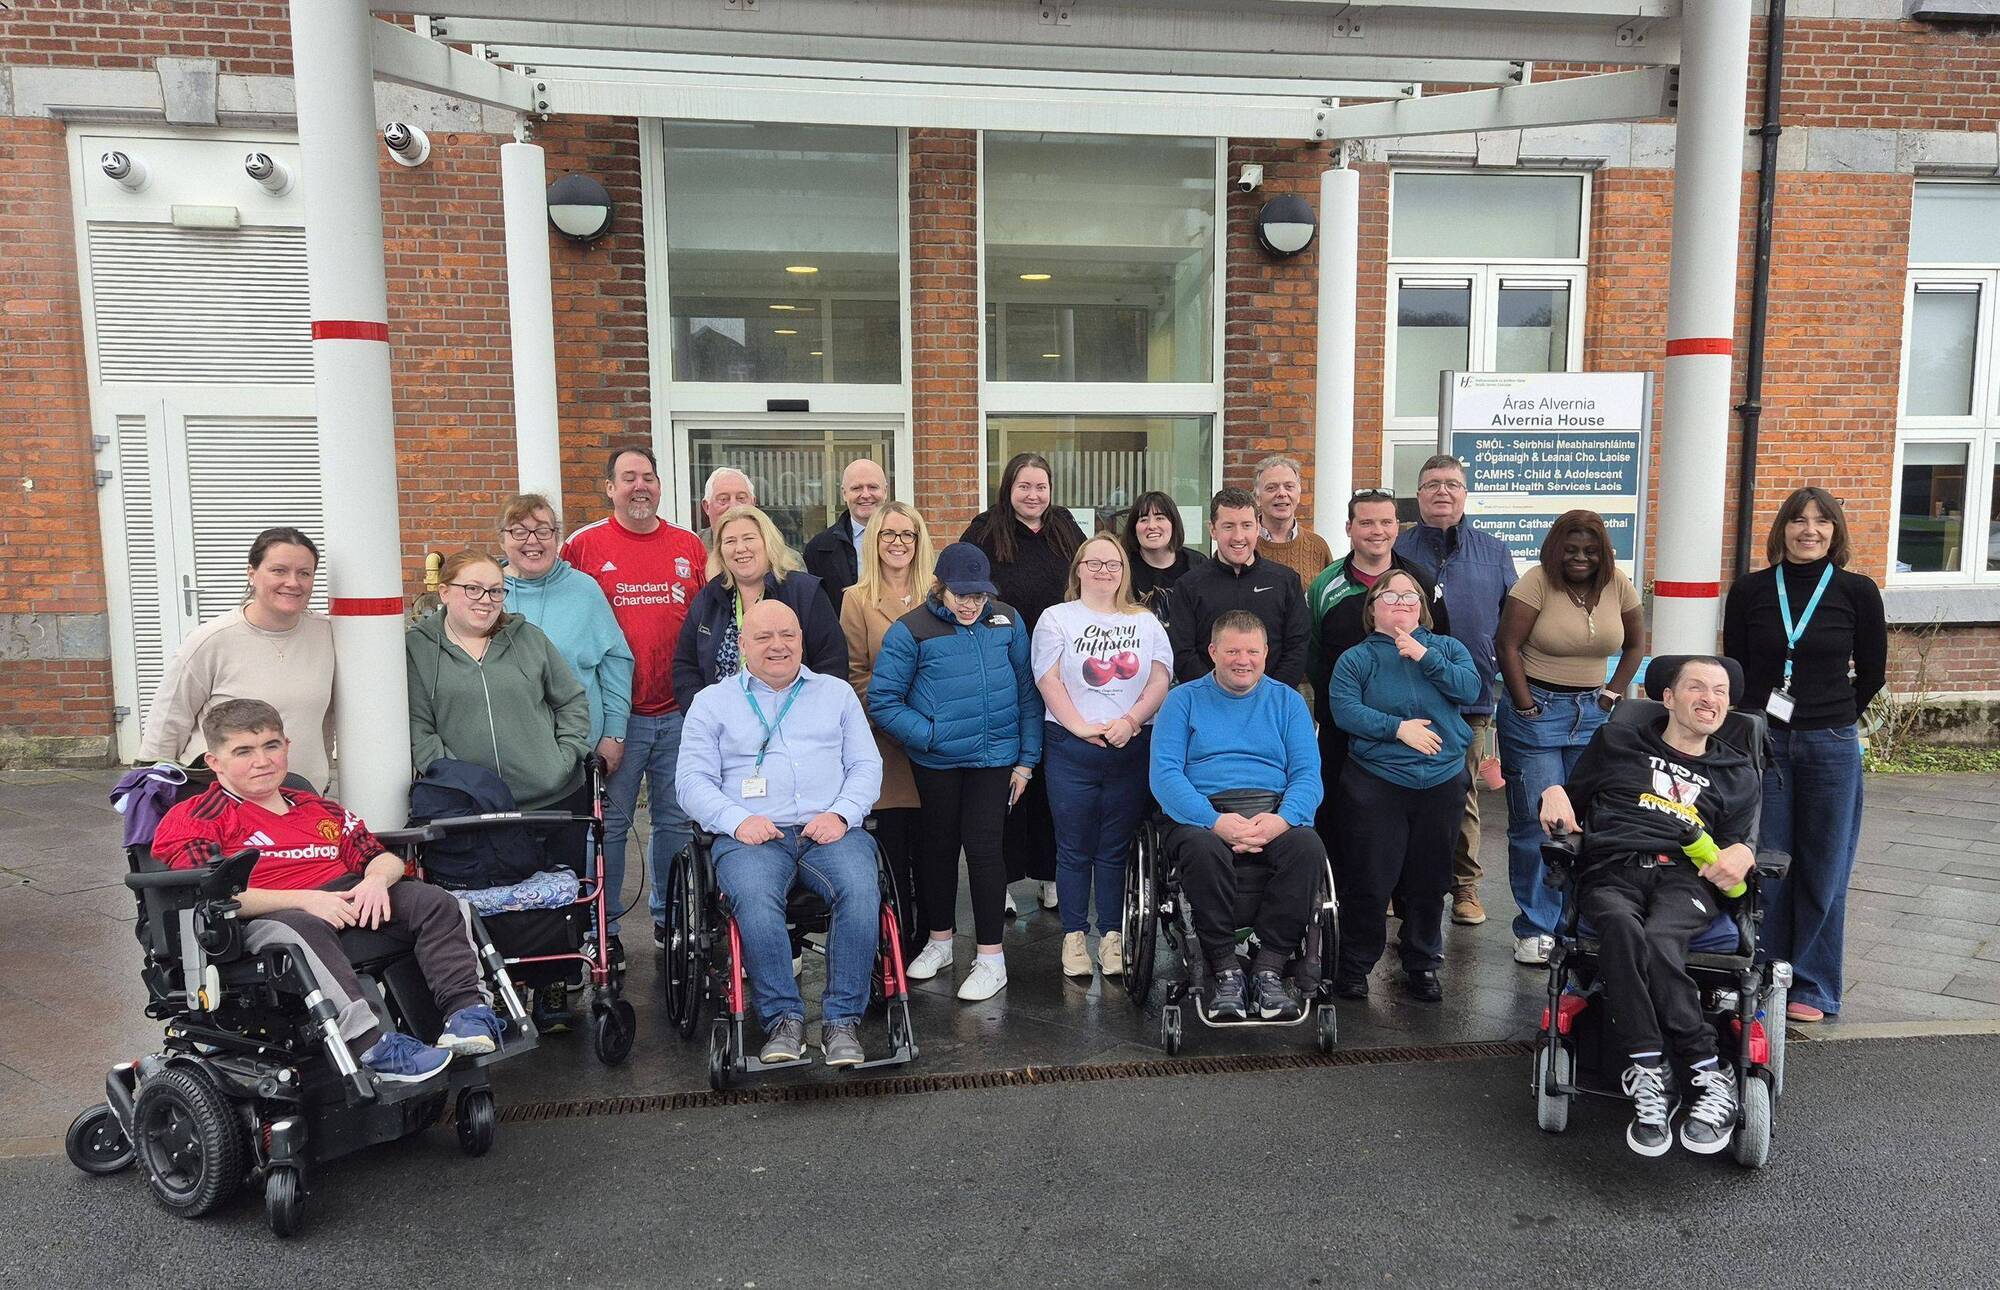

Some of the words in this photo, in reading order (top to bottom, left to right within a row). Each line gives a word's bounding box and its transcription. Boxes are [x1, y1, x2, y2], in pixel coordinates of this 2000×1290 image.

[1503, 394, 1535, 410] Áras
[1539, 397, 1595, 410] Alvernia
[1491, 414, 1553, 426] Alvernia
[1558, 414, 1605, 426] House
[1476, 438, 1505, 449] SMÓL
[1532, 452, 1540, 462] &
[1575, 453, 1597, 462] Cho.
[1600, 453, 1631, 462] Laoise
[1475, 469, 1515, 479] CAMHS
[1524, 469, 1551, 479] Child
[1554, 470, 1562, 479] &
[1564, 469, 1622, 479] Adolescent
[1474, 482, 1509, 491] Mental
[1511, 482, 1544, 491] Health
[1547, 482, 1591, 491] Services
[1594, 482, 1622, 491] Laois
[1473, 519, 1516, 529] Cumann
[1604, 518, 1628, 529] othaí
[616, 582, 669, 593] Standard
[613, 594, 671, 607] Chartered
[1084, 624, 1136, 638] Cherry
[1074, 637, 1140, 656] Infusion
[1692, 773, 1710, 787] IS
